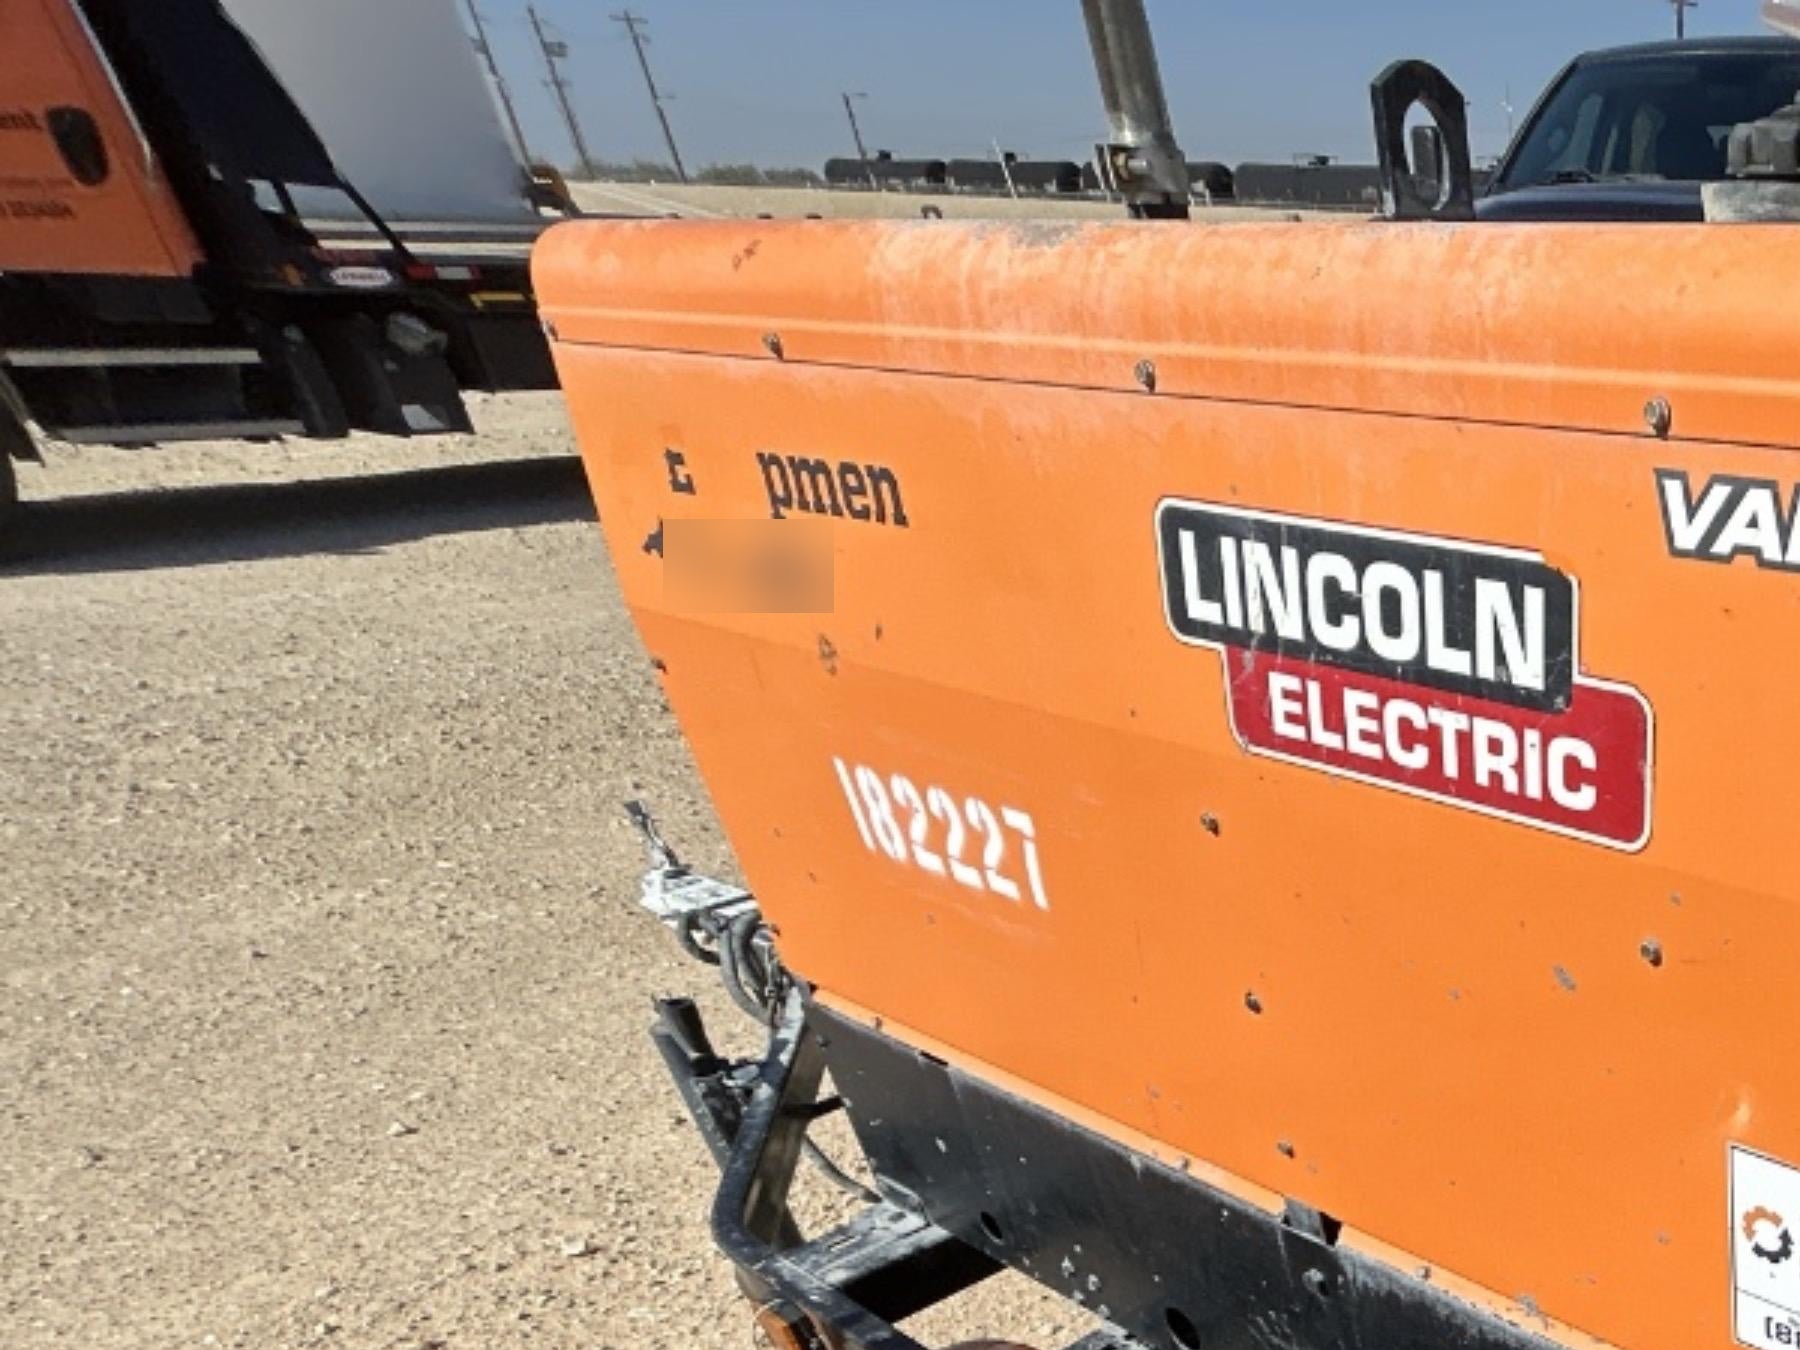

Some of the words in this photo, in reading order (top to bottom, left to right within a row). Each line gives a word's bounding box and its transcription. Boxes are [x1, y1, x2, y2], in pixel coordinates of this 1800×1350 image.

[1178, 528, 1547, 691] LINCOLN
[1266, 671, 1599, 813] ELECTRIC
[833, 757, 1050, 911] 182227
